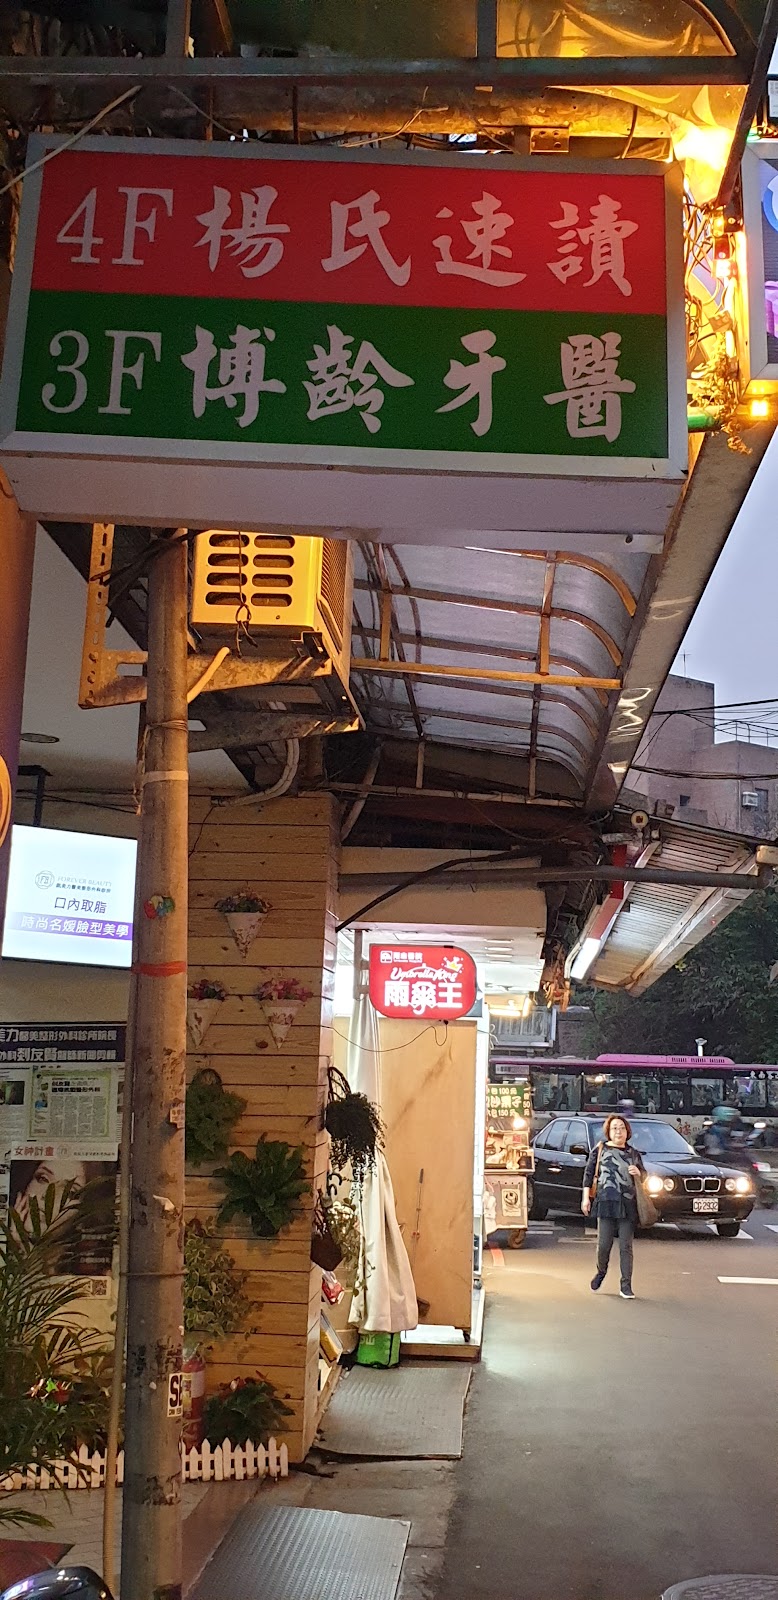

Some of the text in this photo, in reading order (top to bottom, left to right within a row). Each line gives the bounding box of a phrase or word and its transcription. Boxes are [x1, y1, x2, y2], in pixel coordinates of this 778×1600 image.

[54, 897, 107, 914] 口內取脂
[21, 915, 129, 937] 時尚名媛臉型美學
[384, 981, 463, 1014] 雨傘王
